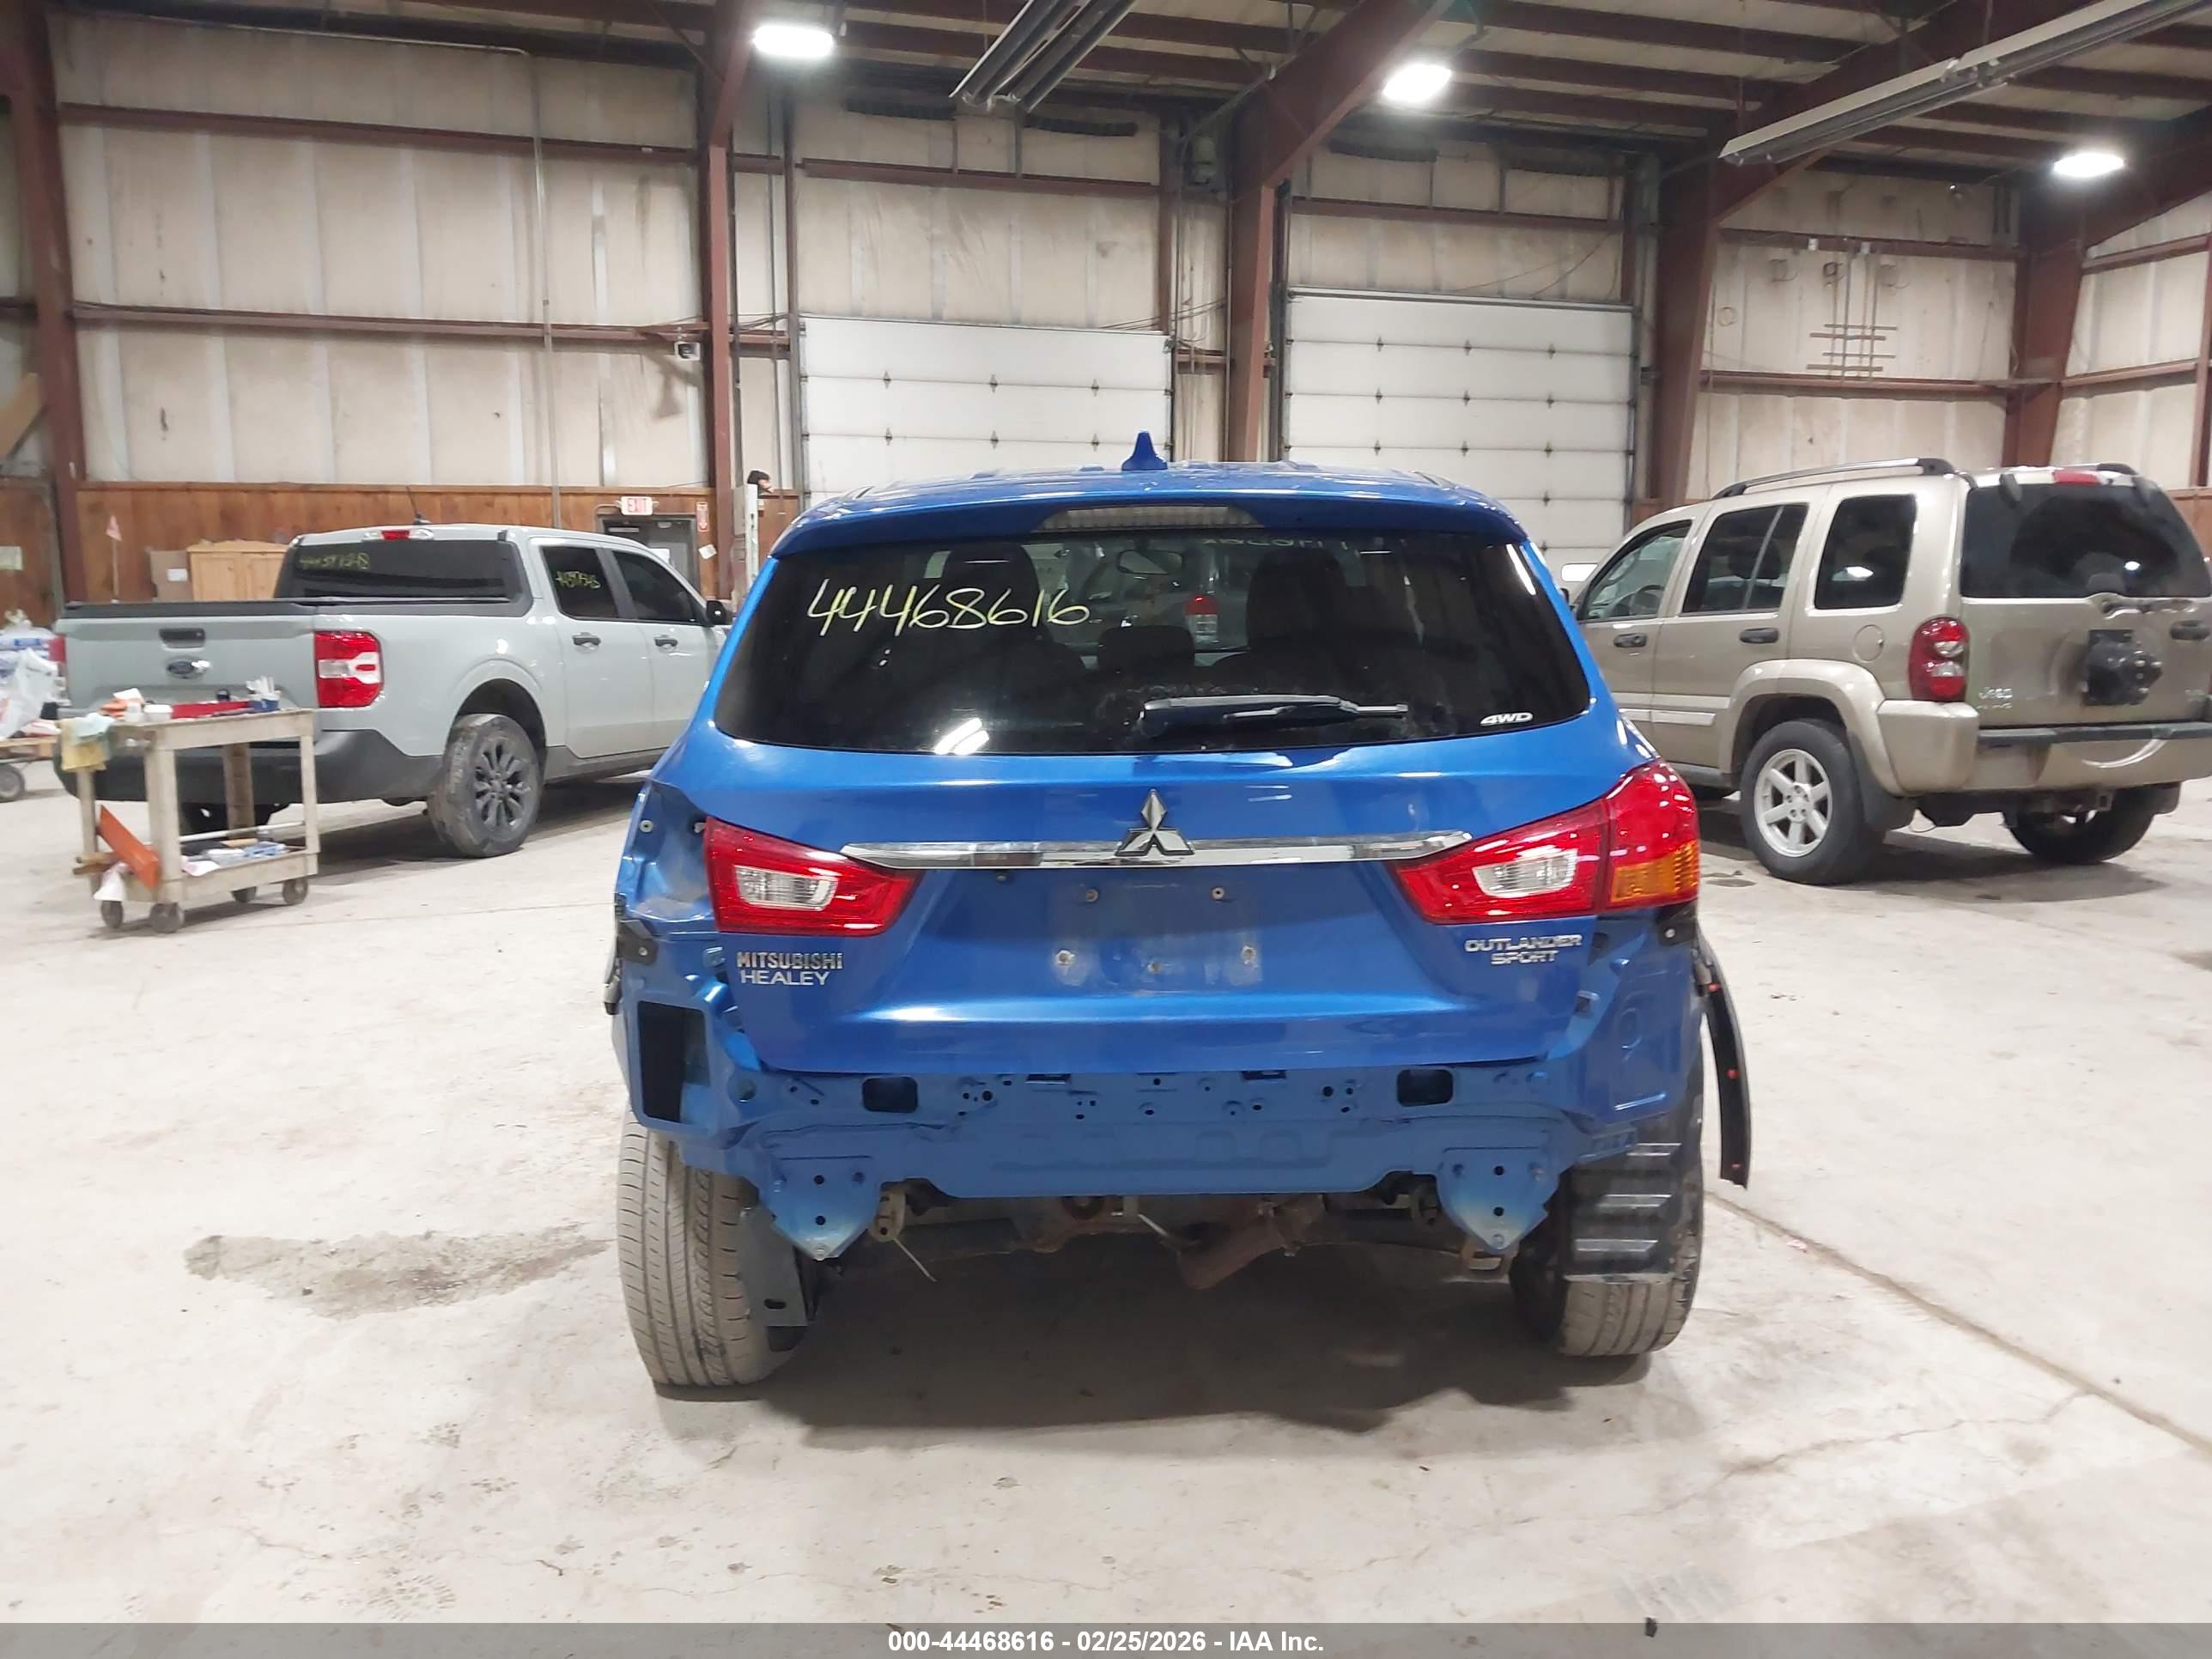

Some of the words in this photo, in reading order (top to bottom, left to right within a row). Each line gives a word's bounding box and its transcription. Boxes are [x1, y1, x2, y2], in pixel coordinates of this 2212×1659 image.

[807, 578, 1091, 636] 44468616
[1480, 712, 1533, 726] 4WD
[1465, 934, 1583, 951] OUTLANDER
[737, 951, 843, 969] MITSUBISHI
[1491, 950, 1559, 965] SPORT
[740, 969, 830, 986] HEALEY
